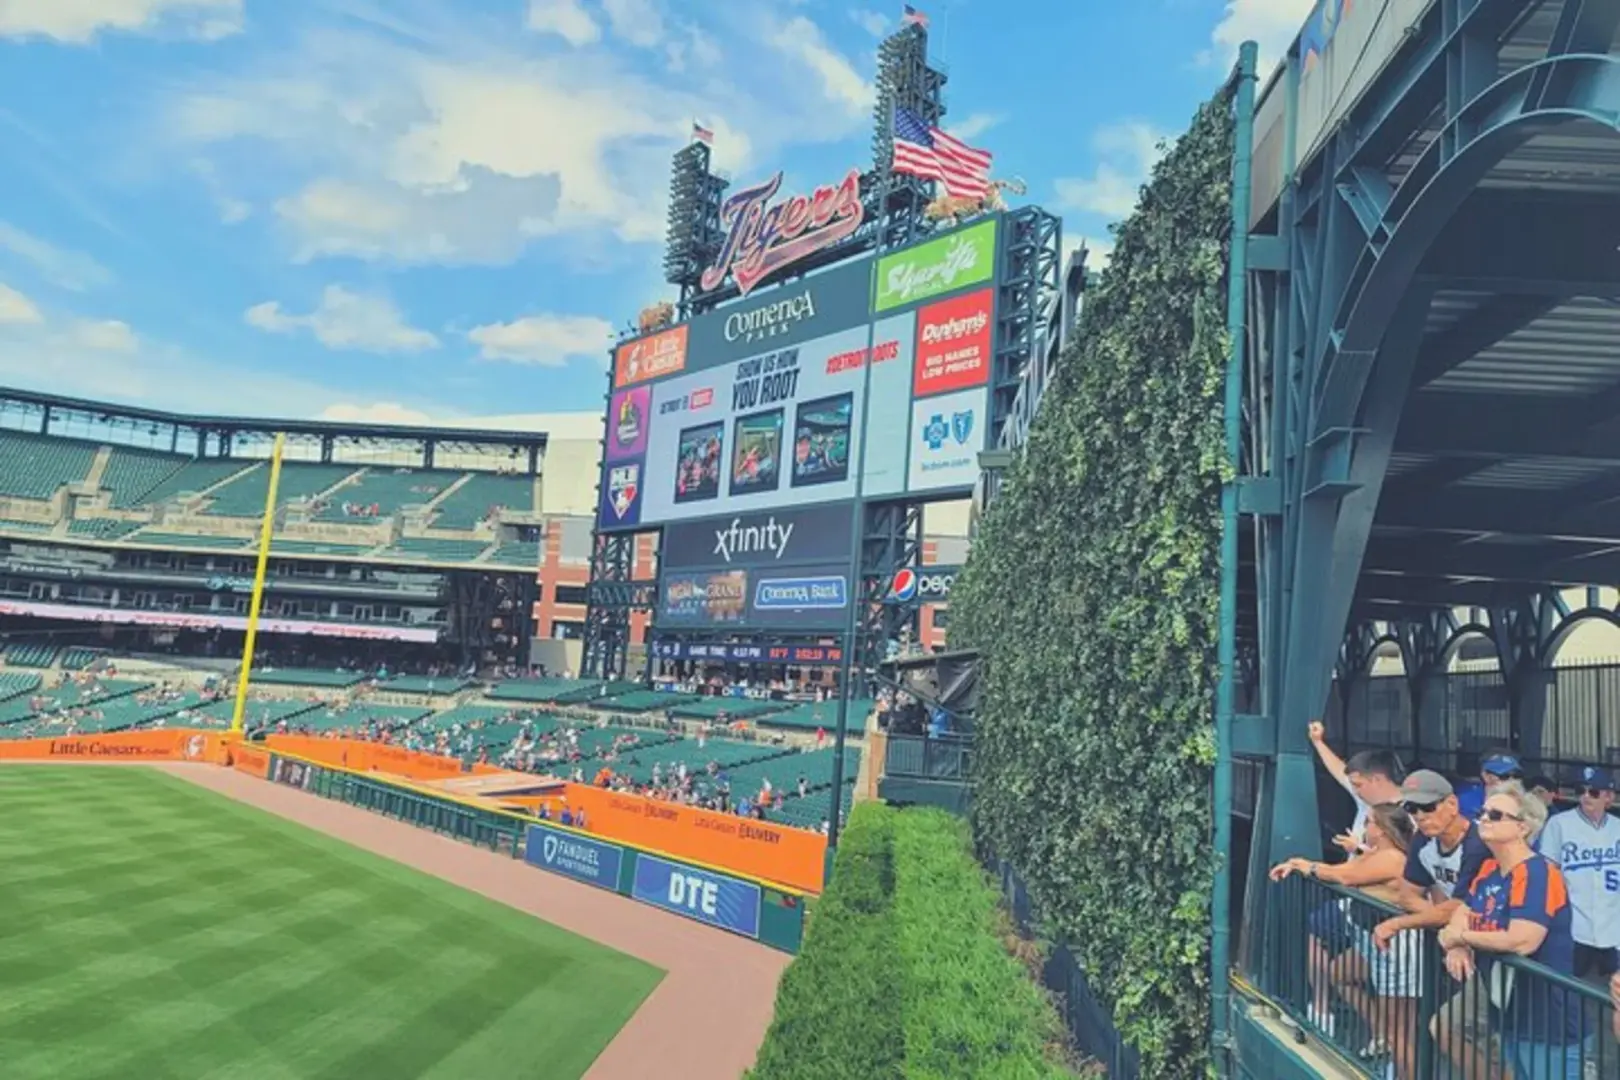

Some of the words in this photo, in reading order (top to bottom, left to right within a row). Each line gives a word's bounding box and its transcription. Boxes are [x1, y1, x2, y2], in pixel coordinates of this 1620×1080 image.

[701, 169, 863, 292] Tigers
[736, 357, 761, 381] SHOW
[777, 347, 800, 369] HOW
[731, 376, 761, 412] YOU
[760, 368, 801, 405] ROOT
[713, 516, 794, 562] xfinity
[50, 740, 88, 755] Little
[89, 742, 142, 756] Caesars
[668, 872, 718, 915] DTE
[1604, 870, 1619, 892] 5
